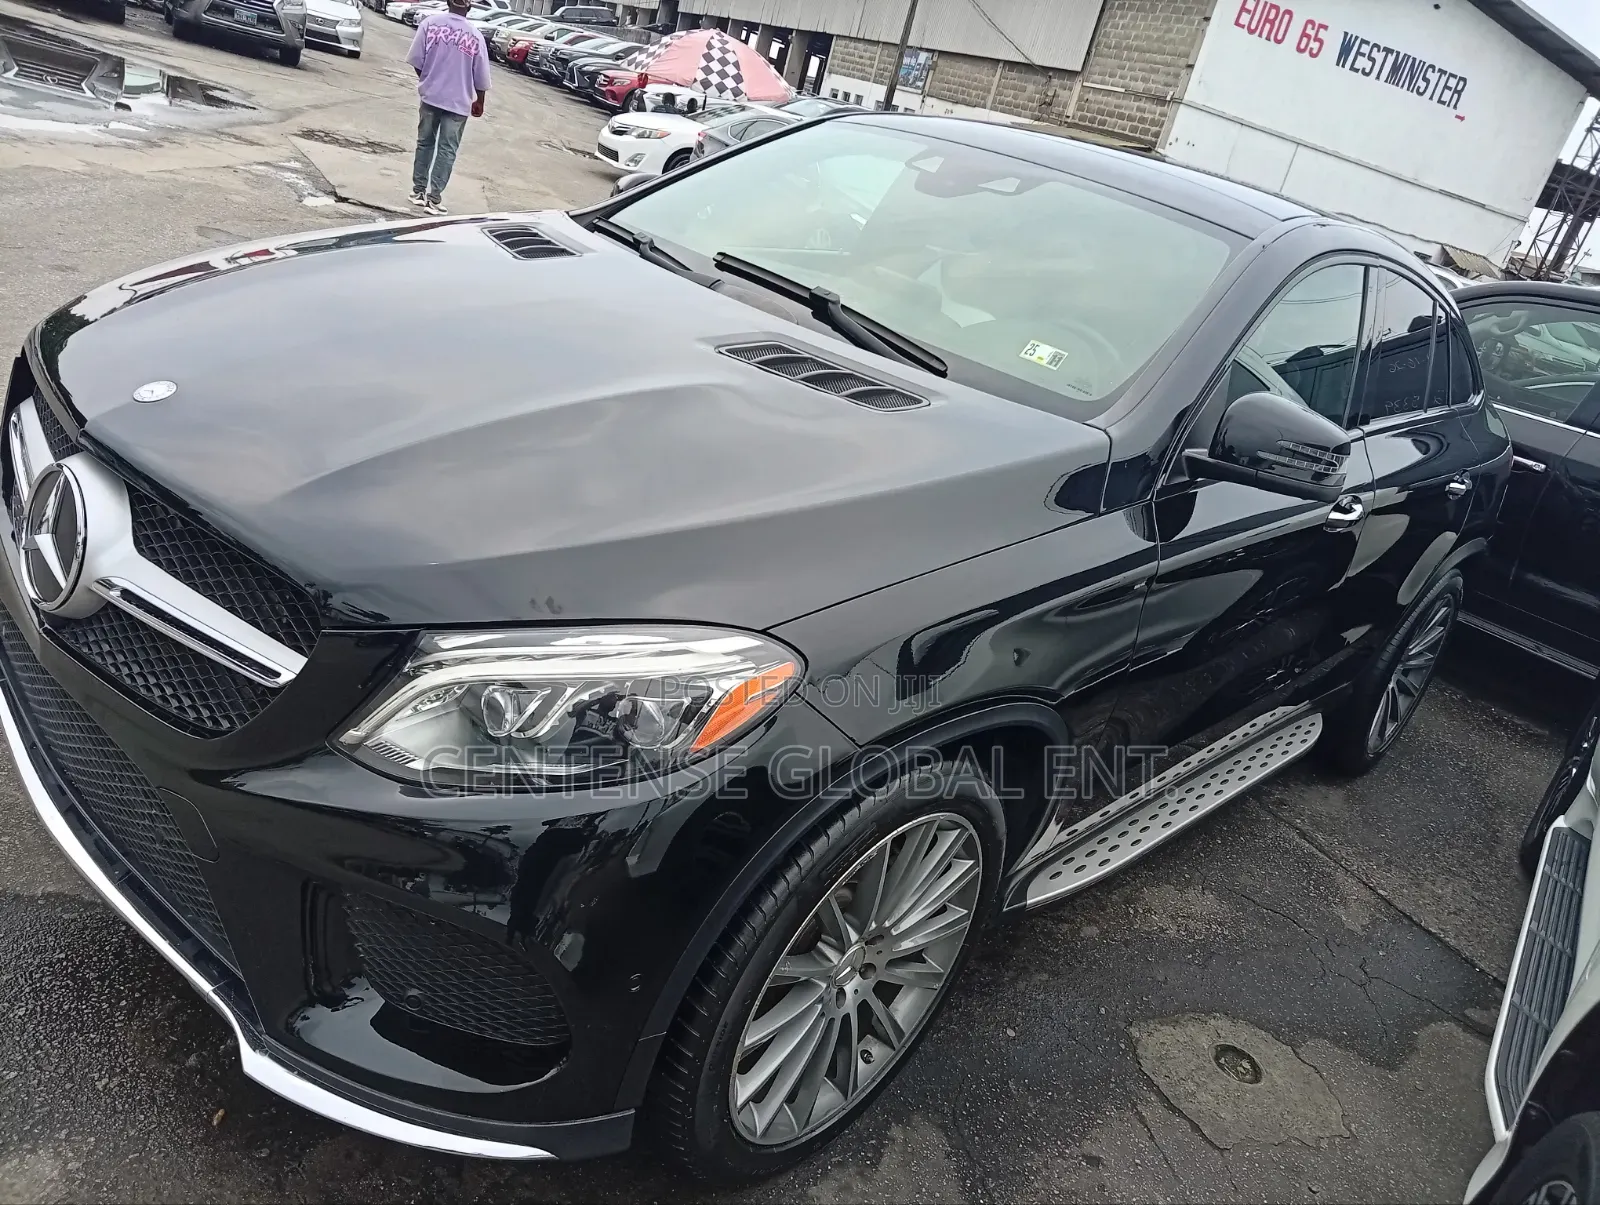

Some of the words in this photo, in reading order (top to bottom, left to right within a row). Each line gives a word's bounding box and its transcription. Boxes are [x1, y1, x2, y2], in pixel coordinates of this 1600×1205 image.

[425, 23, 480, 55] BRAND
[1233, 0, 1294, 45] EURO
[1295, 19, 1329, 59] 65
[1335, 31, 1468, 111] WESTMINISTER
[1024, 343, 1040, 356] 25
